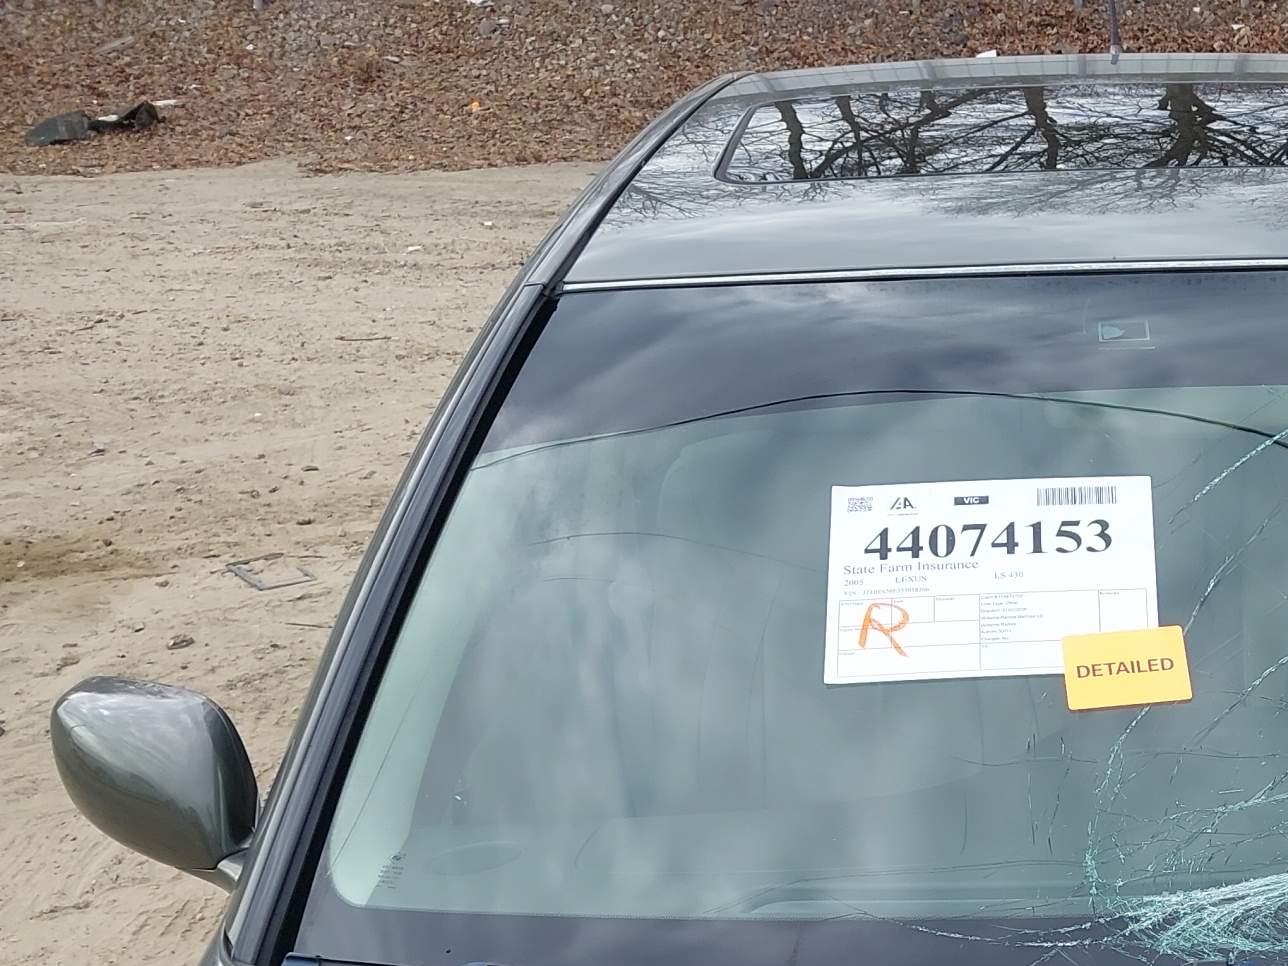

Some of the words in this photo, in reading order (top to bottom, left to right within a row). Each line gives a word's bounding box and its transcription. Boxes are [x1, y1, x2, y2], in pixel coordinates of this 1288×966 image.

[962, 497, 980, 505] VIC
[864, 519, 1112, 560] 44074153
[843, 565, 875, 576] State
[879, 563, 912, 574] Farm
[917, 560, 979, 572] Insurance
[858, 602, 911, 658] R
[1076, 657, 1175, 679] DETAILED
